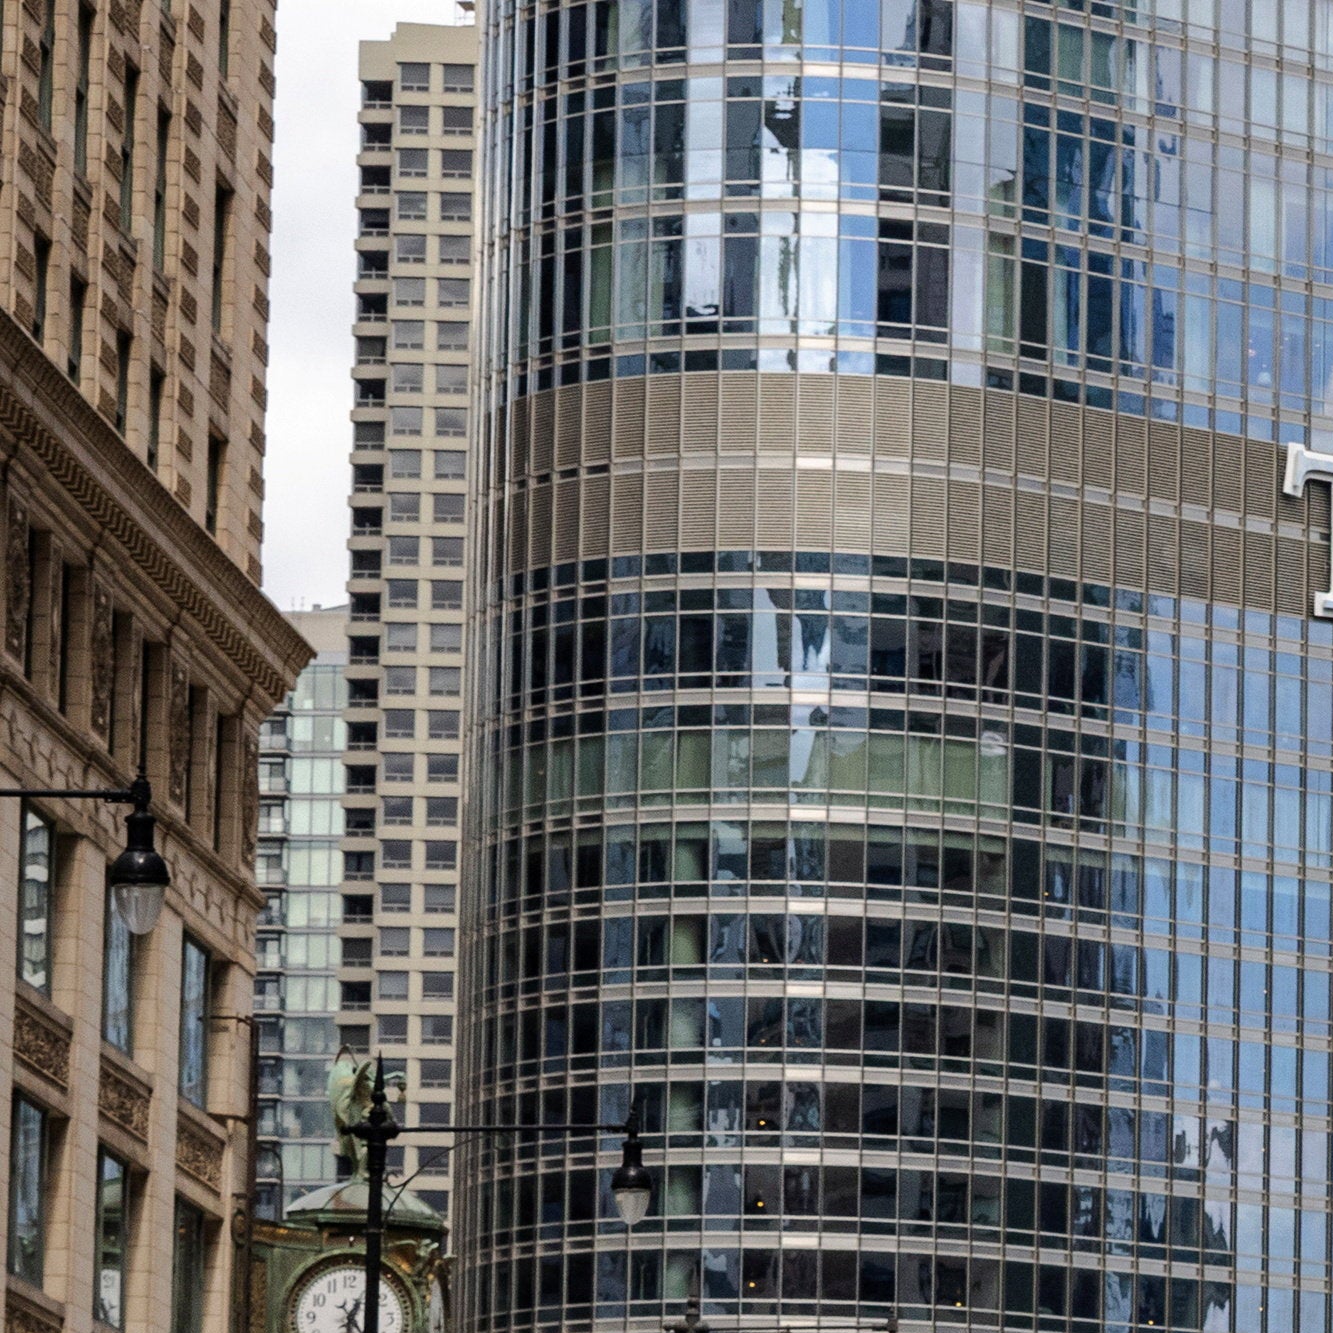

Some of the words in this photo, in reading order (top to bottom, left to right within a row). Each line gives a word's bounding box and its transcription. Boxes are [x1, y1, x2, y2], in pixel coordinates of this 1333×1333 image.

[327, 1277, 337, 1294] 11
[342, 1274, 357, 1289] 12
[313, 1292, 326, 1308] 10
[306, 1311, 316, 1325] 9
[386, 1312, 395, 1326] 3
